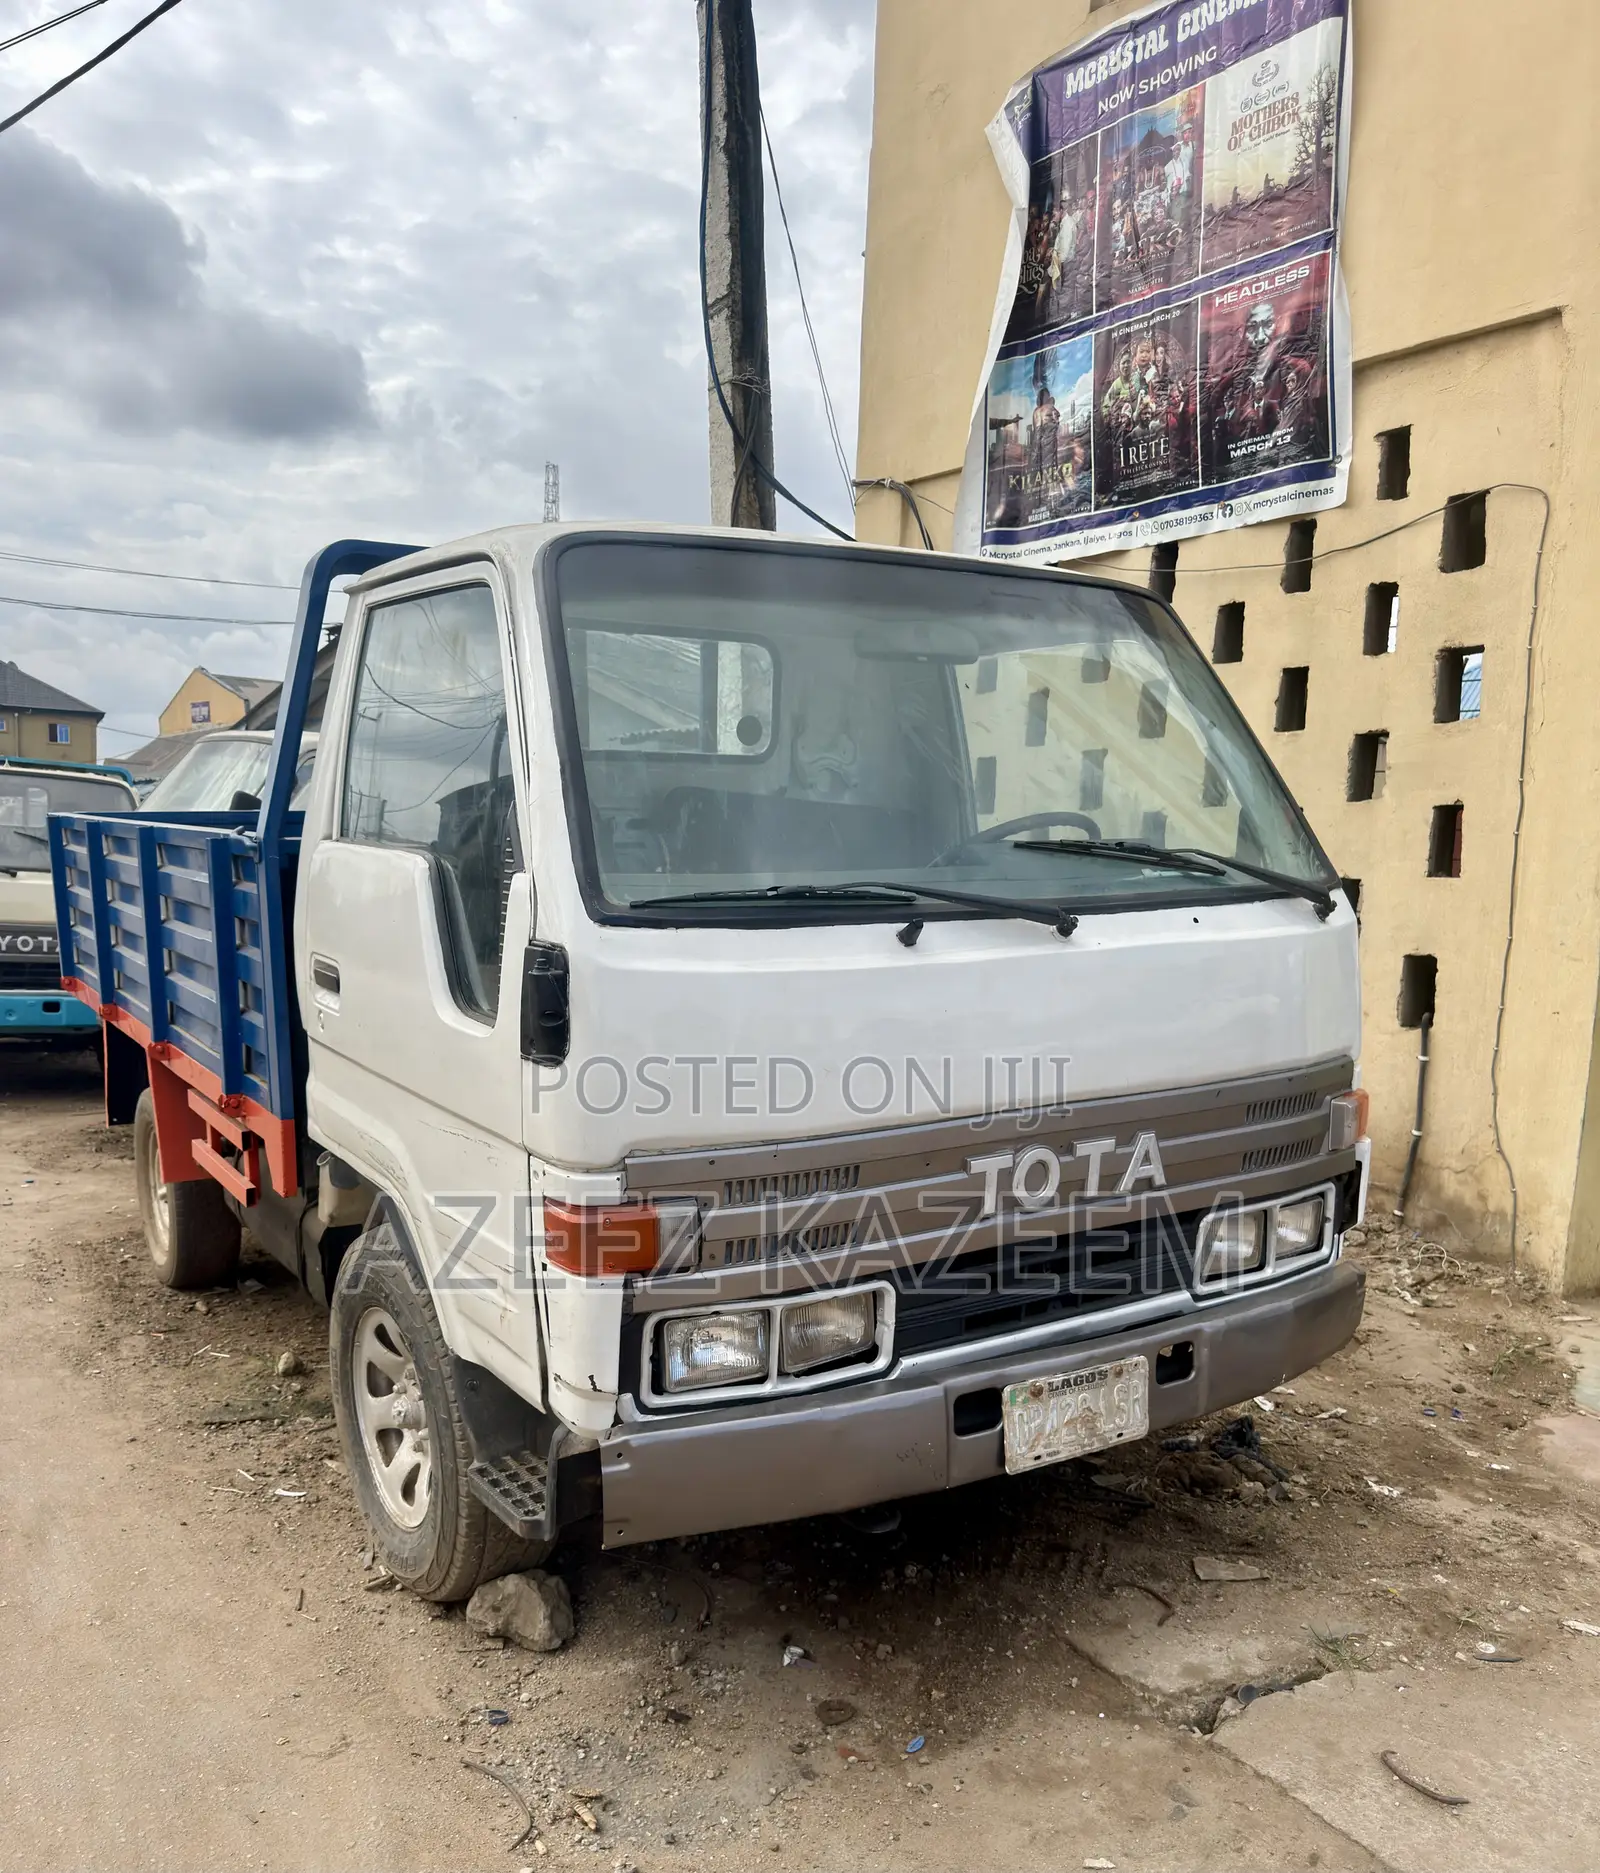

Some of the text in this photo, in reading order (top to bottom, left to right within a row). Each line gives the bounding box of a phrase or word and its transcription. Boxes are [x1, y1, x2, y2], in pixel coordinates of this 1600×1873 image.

[1065, 24, 1169, 99] MCRYSTAL
[1097, 84, 1135, 115] NOW
[1138, 45, 1217, 94] SHOWING
[1227, 132, 1245, 152] OF
[1248, 107, 1301, 142] CHIBOK
[1230, 92, 1300, 137] MOTHERS
[1214, 264, 1310, 308] HEADLESS
[1118, 320, 1149, 335] CINEMAS
[1171, 309, 1181, 319] 20
[1227, 426, 1294, 450] IN CINEMAS FROM
[1229, 434, 1292, 459] MARCH 13
[989, 548, 1022, 560] Mcrystal
[1023, 544, 1053, 557] Cinema,
[1160, 512, 1214, 531] 07038199363
[1252, 485, 1334, 511] mcrystalcinemas
[0, 935, 60, 953] YOT
[966, 1130, 1167, 1217] TOTA
[1047, 1370, 1109, 1393] LAGOS
